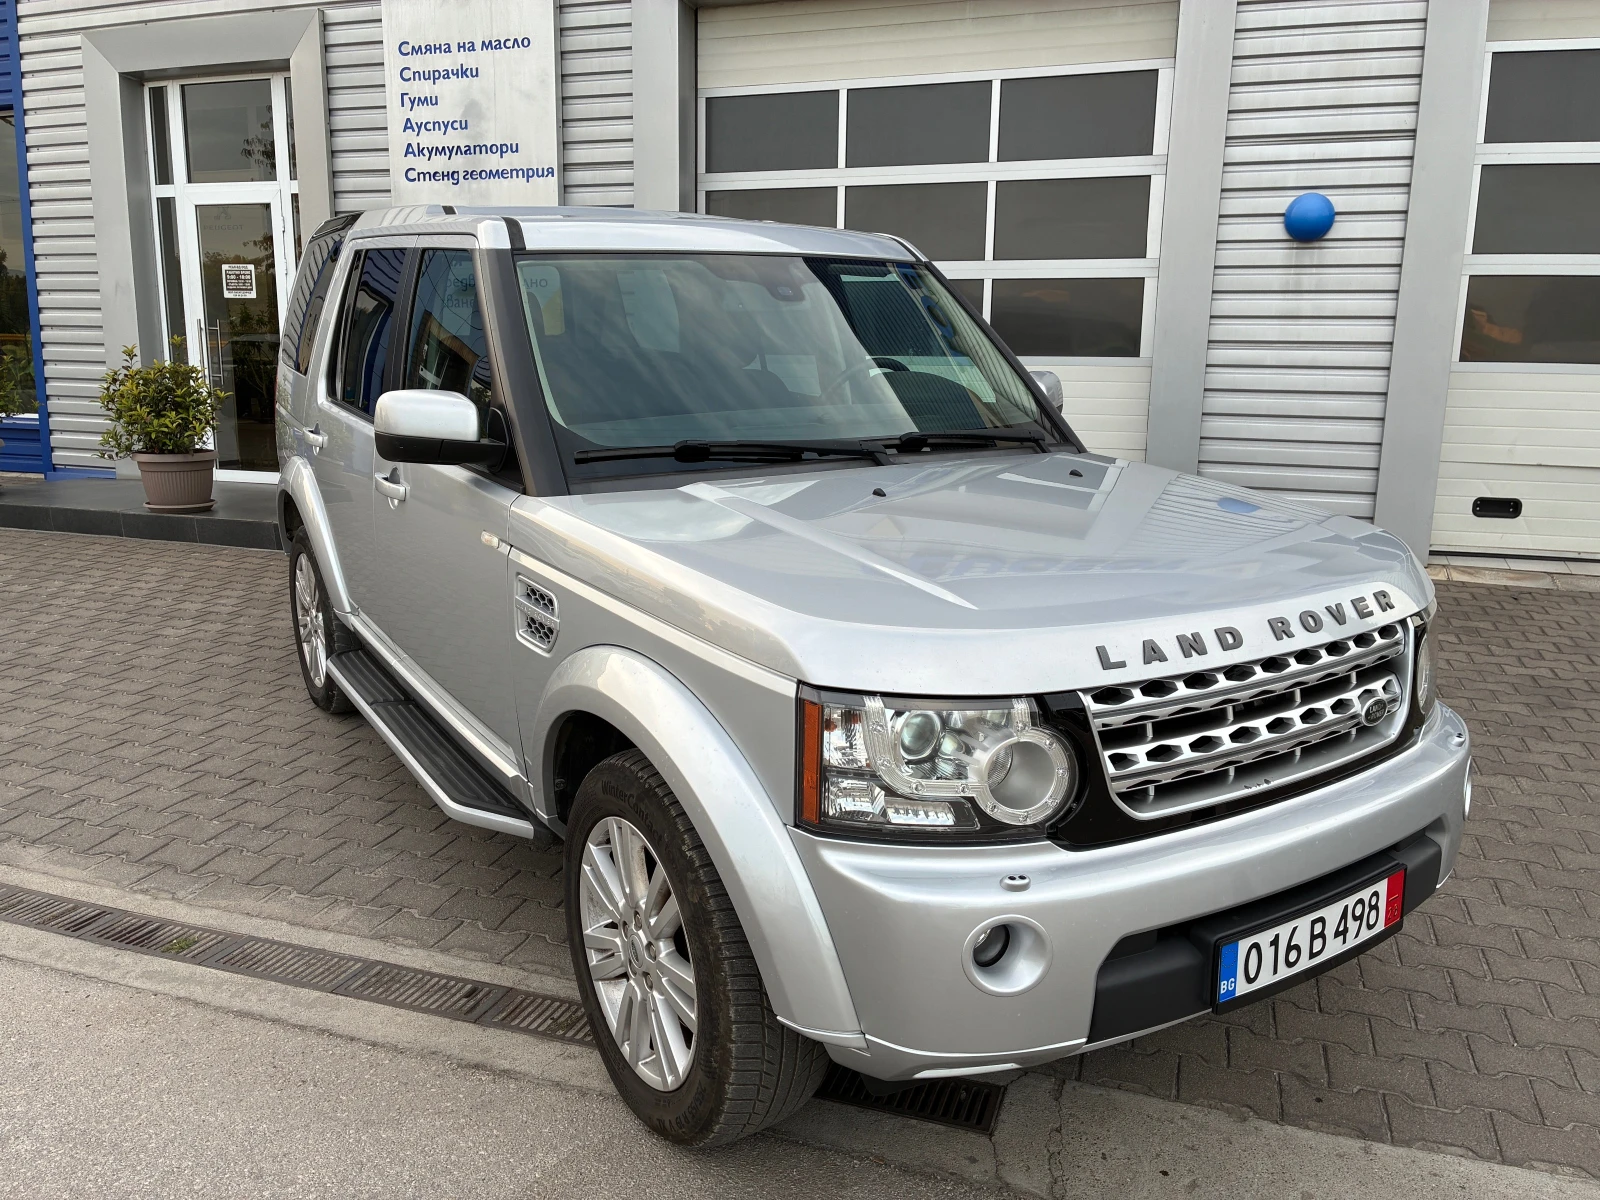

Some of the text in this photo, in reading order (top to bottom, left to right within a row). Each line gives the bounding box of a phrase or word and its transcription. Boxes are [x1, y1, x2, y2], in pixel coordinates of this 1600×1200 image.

[398, 37, 531, 57] Смяна на масло
[399, 64, 479, 85] Спирачки
[400, 92, 439, 111] Гуми
[402, 117, 469, 136] Ауспуси
[403, 142, 519, 161] Акумулатори
[404, 166, 555, 185] Стенд геометрия
[1096, 589, 1396, 670] LAND ROVER
[1219, 977, 1235, 994] BG
